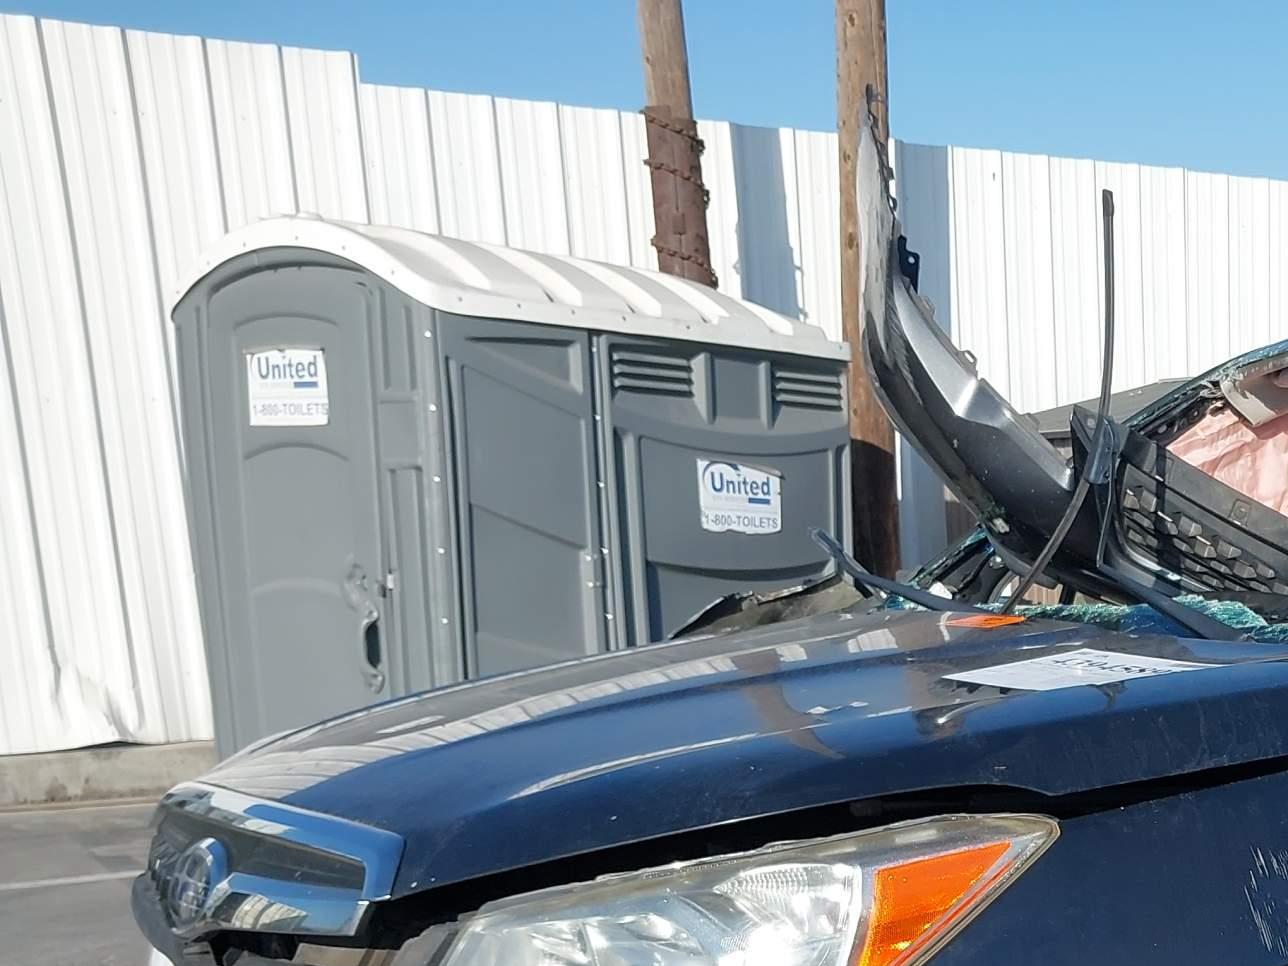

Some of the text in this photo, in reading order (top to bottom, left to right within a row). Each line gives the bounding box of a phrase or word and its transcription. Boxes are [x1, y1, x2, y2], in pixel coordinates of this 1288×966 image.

[257, 354, 318, 380] United
[253, 402, 329, 416] 1-800-TOILETS
[710, 471, 771, 496] United
[704, 513, 778, 529] 1-800-TOILETS
